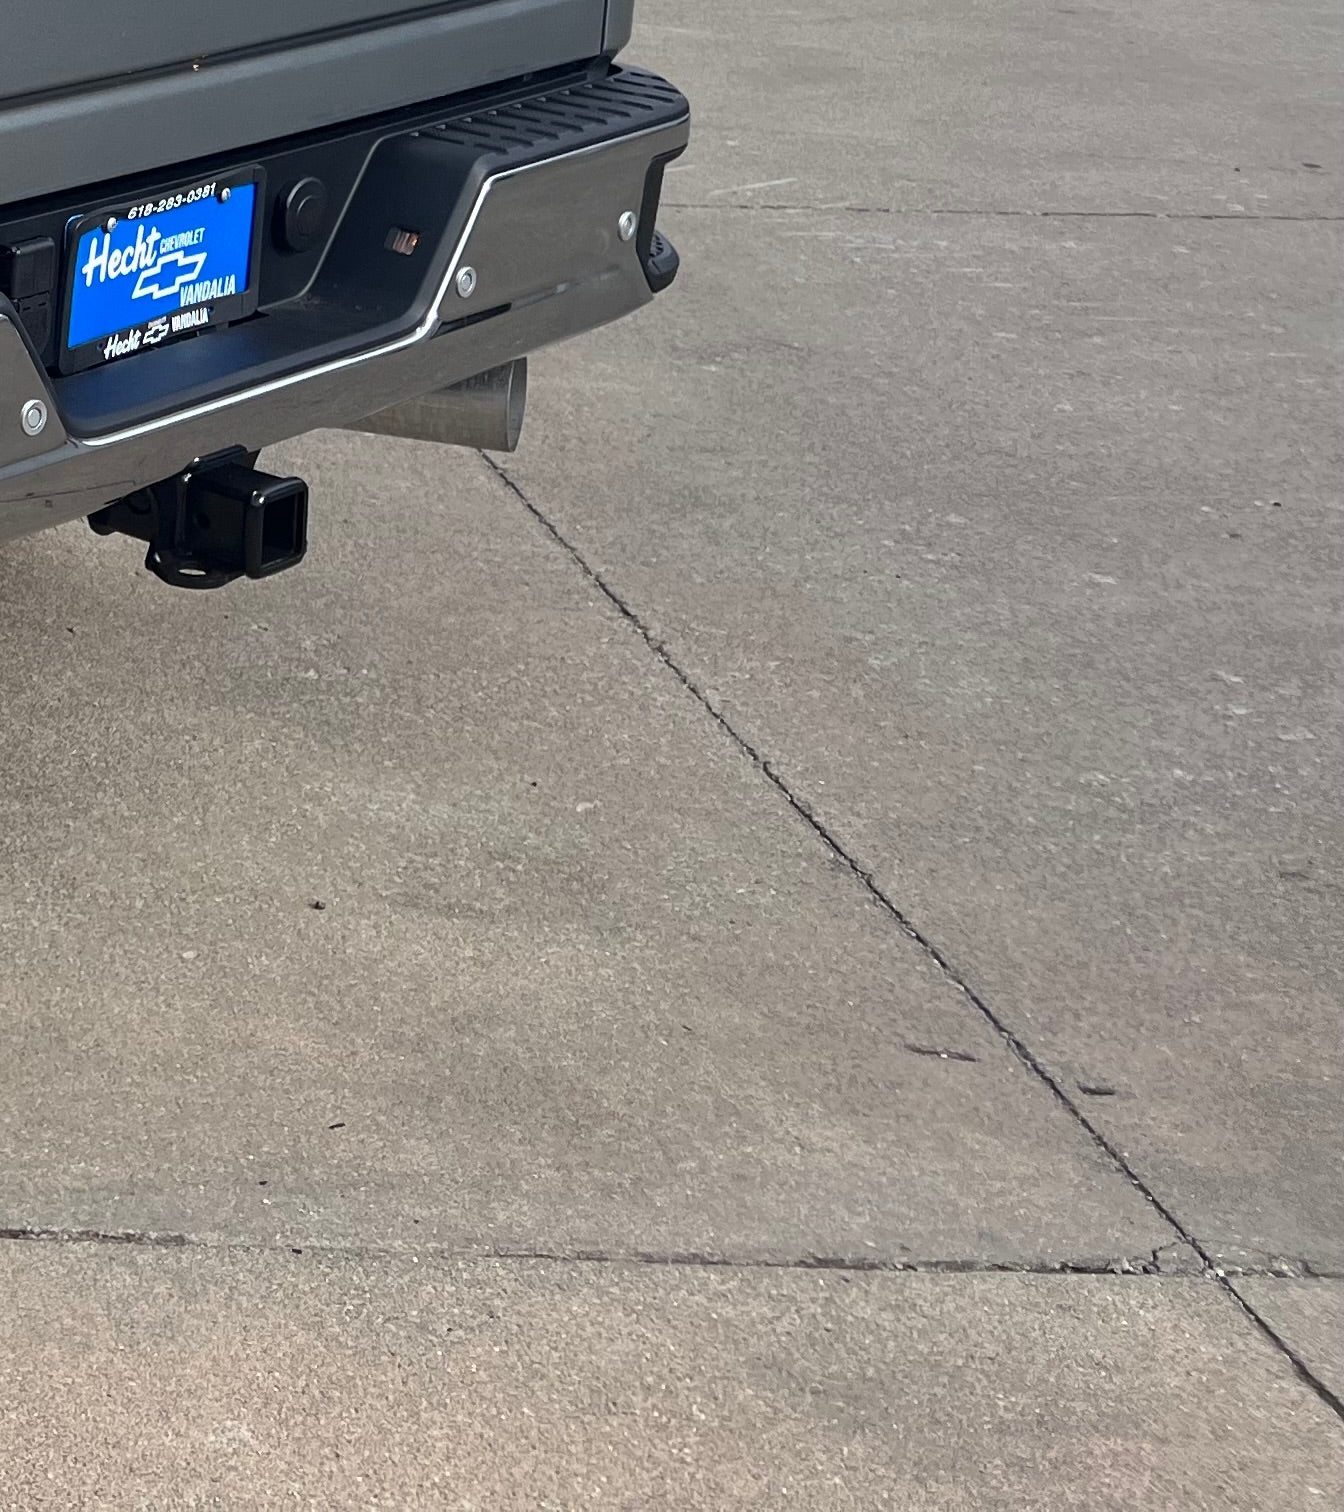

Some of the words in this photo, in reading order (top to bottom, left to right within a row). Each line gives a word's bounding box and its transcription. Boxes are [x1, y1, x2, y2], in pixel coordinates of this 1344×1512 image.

[127, 182, 217, 219] 618-283-0381
[81, 224, 161, 288] Hecht
[159, 227, 206, 254] CHEVROLET
[179, 274, 236, 308] VANDALIA
[171, 307, 209, 333] VANDALIA
[103, 329, 142, 360] Hecht
